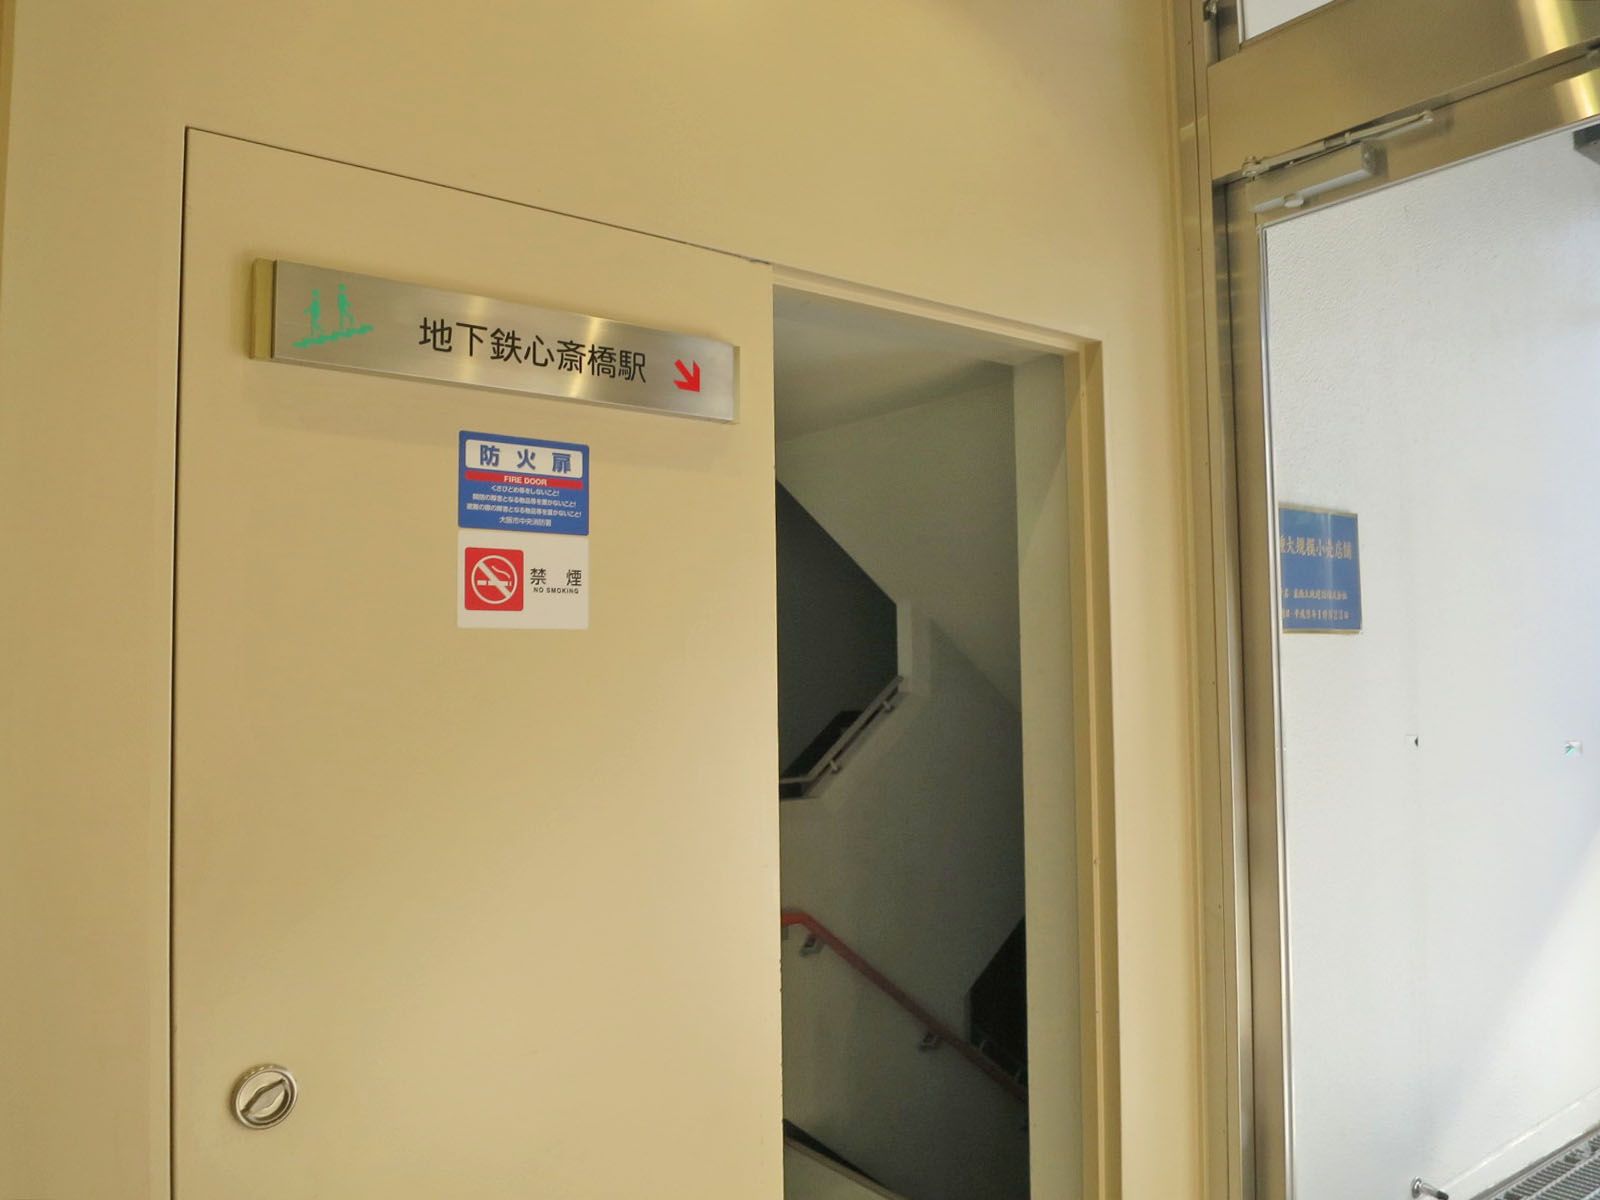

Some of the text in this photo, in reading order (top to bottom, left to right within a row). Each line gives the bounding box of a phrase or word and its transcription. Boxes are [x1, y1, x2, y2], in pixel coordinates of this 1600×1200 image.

[418, 316, 647, 383] 地下鉄心斎橋駅
[479, 444, 572, 474] 防火扉
[503, 475, 548, 486] FIRE DOOR
[530, 567, 582, 587] 禁煙
[533, 586, 580, 595] NO SMOKING
